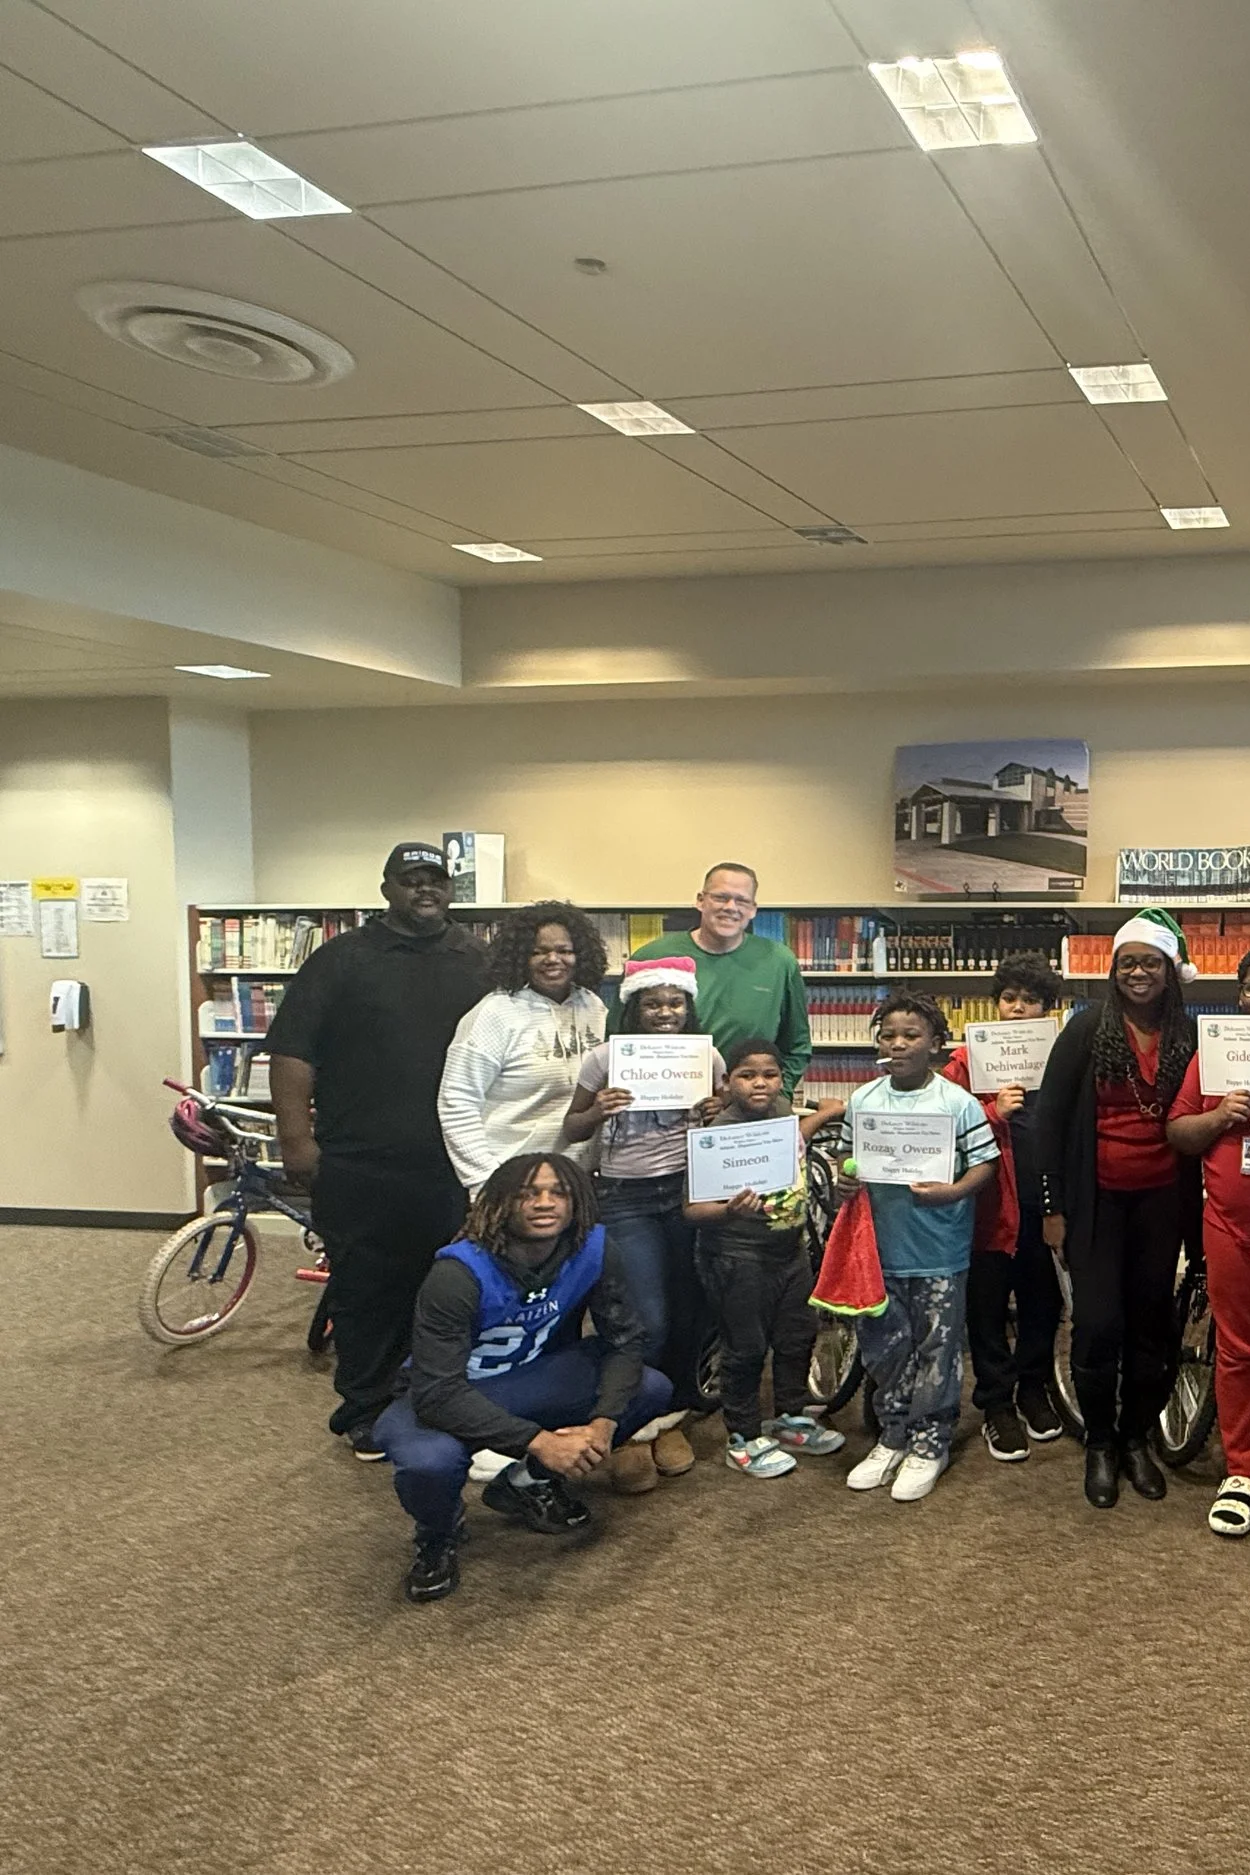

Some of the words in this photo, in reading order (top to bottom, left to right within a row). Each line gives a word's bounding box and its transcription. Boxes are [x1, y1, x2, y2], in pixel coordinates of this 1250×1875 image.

[1121, 851, 1193, 871] WORLD
[1000, 1044, 1029, 1056] Mark
[985, 1059, 1046, 1072] Dehiwalage
[620, 1067, 658, 1081] Chloe
[661, 1068, 704, 1080] Owens
[862, 1141, 897, 1156] Rozay
[902, 1144, 942, 1154] Owens
[722, 1154, 769, 1169] Simeon
